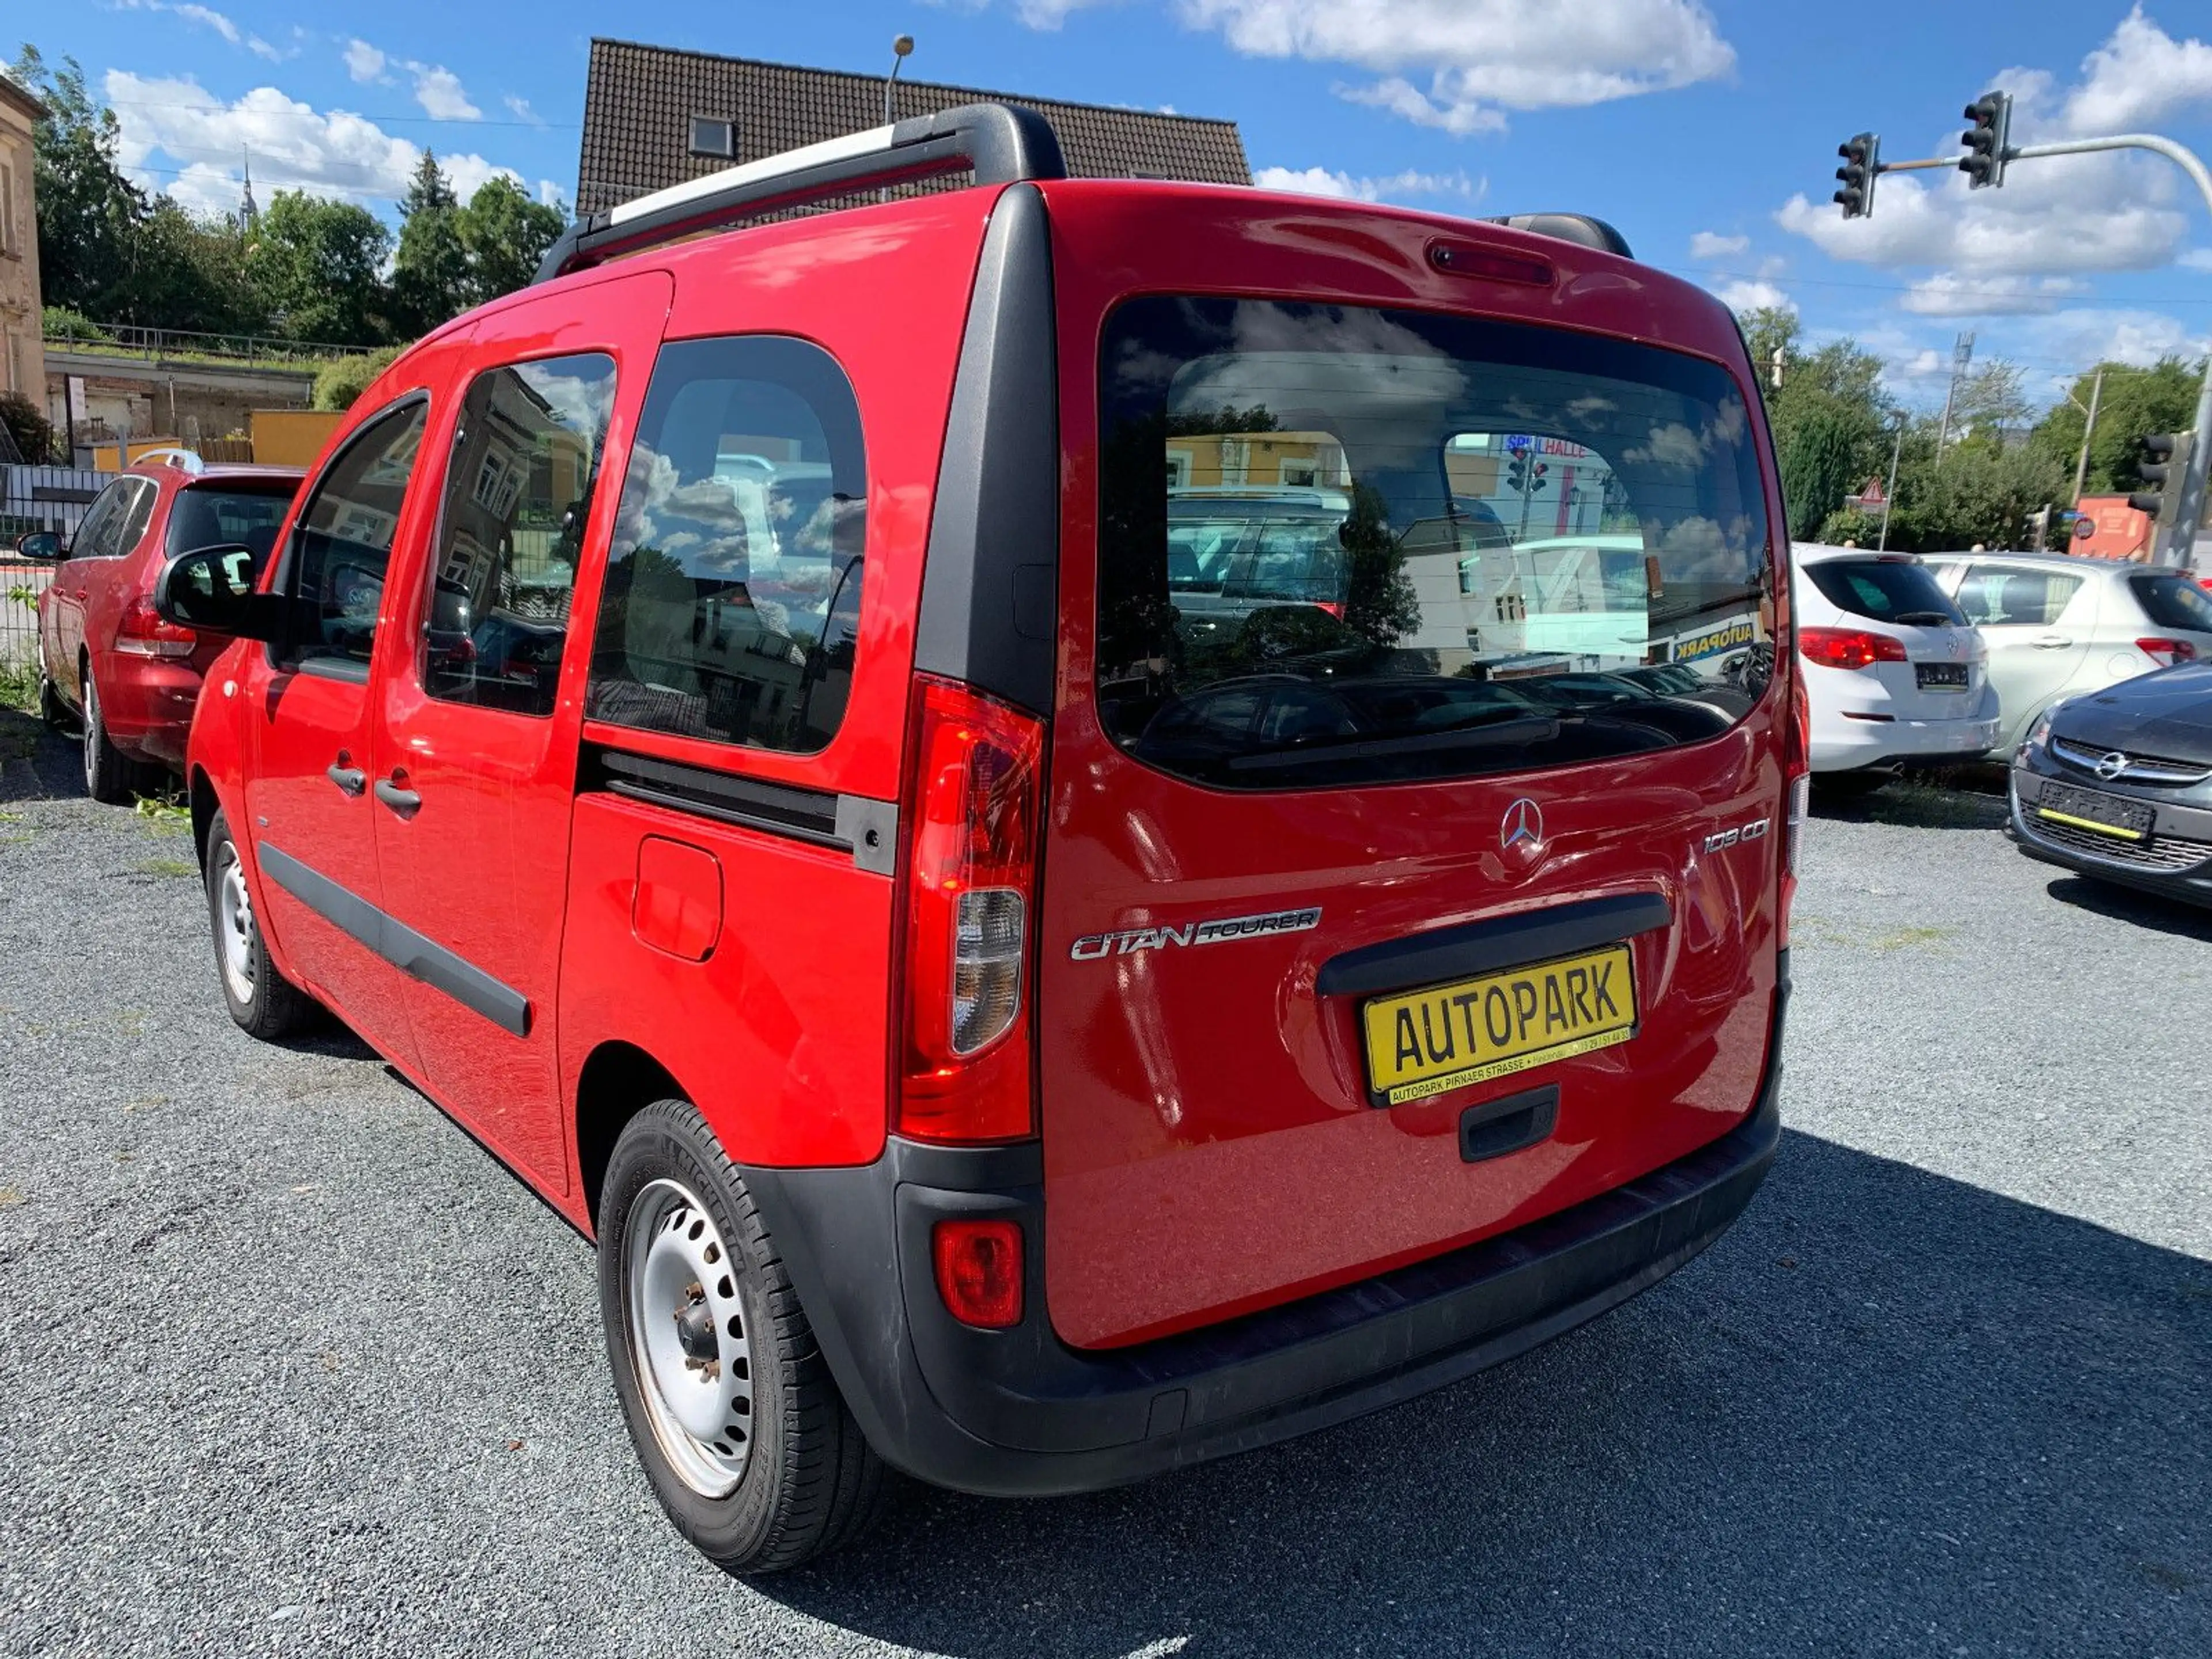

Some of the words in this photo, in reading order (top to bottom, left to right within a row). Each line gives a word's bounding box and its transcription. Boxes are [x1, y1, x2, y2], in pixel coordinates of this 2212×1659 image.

[1071, 923, 1195, 961] CITAN
[1205, 911, 1317, 940] TOURER
[1396, 960, 1619, 1072] AUTOPARK
[1393, 1081, 1443, 1101] AUTOPARK
[1445, 1070, 1484, 1089] PIRNAER
[1486, 1059, 1525, 1078] STRASSE
[676, 1147, 746, 1271] MICHELIN
